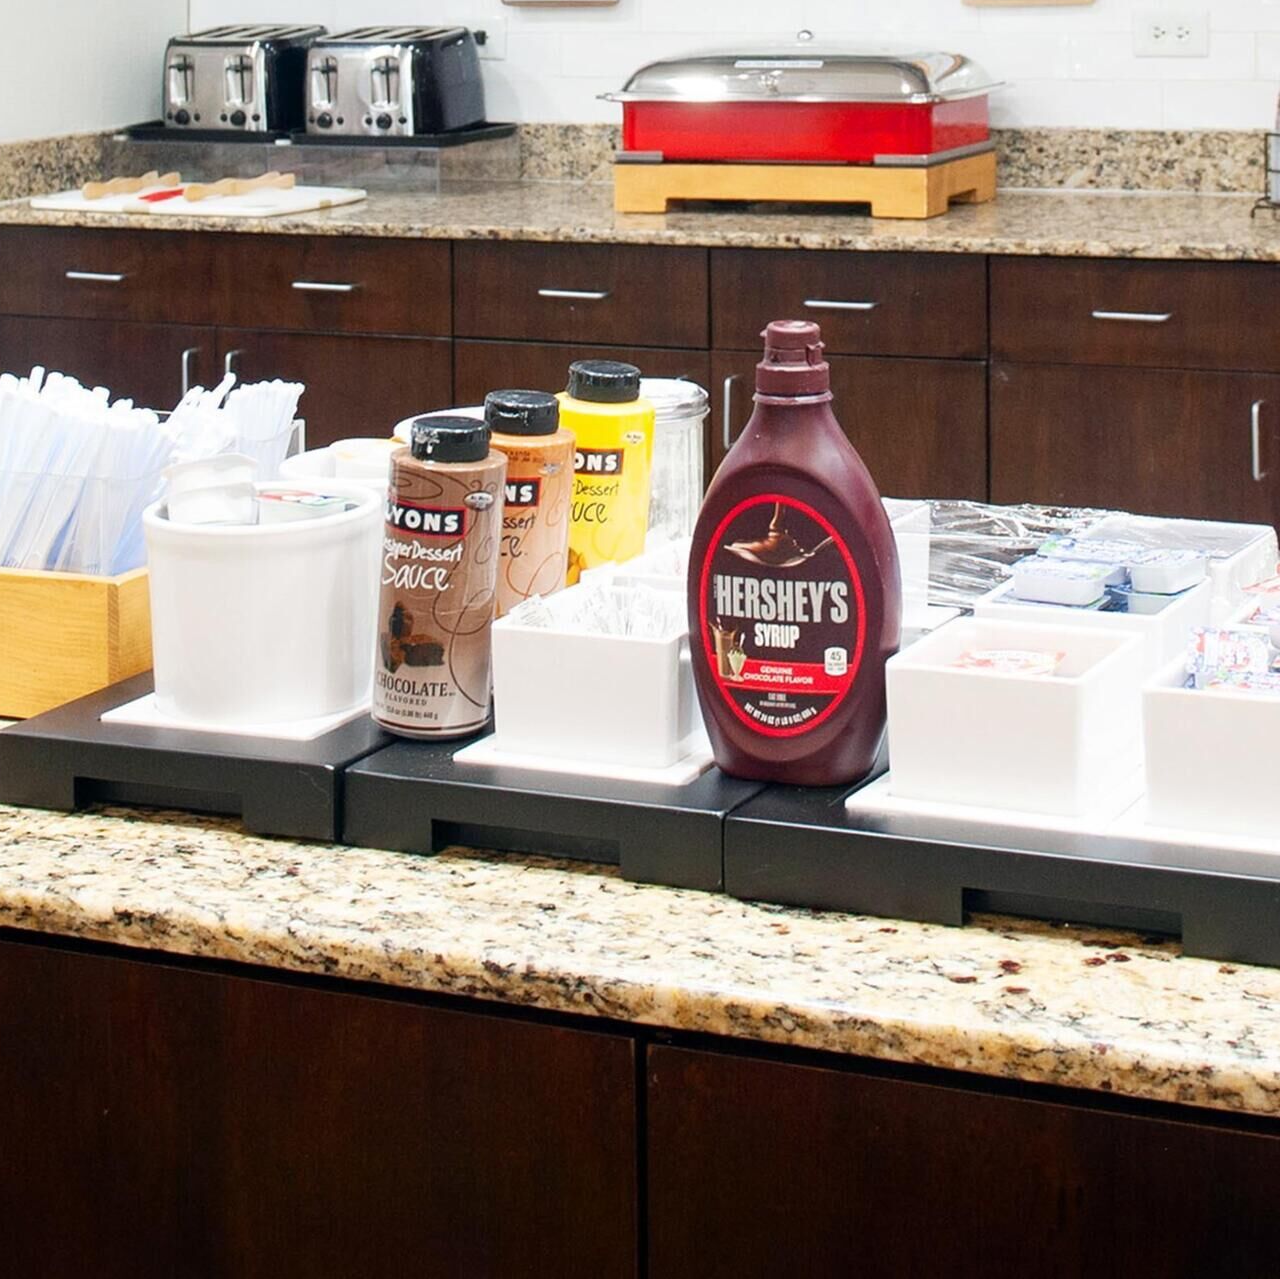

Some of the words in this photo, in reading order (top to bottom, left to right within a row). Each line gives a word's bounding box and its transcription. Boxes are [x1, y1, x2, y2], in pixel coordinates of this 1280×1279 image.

[574, 453, 617, 471] ONS
[576, 479, 619, 496] Dessert
[412, 540, 464, 562] Dessert
[716, 574, 848, 623] HERSHEY'S
[754, 622, 800, 648] SYRUP
[743, 672, 785, 684] CHOCOLATE
[785, 676, 814, 685] FLAVOR
[760, 665, 793, 676] GENUINE
[377, 671, 449, 697] CHOCOLATE
[384, 692, 428, 706] FLAVORED
